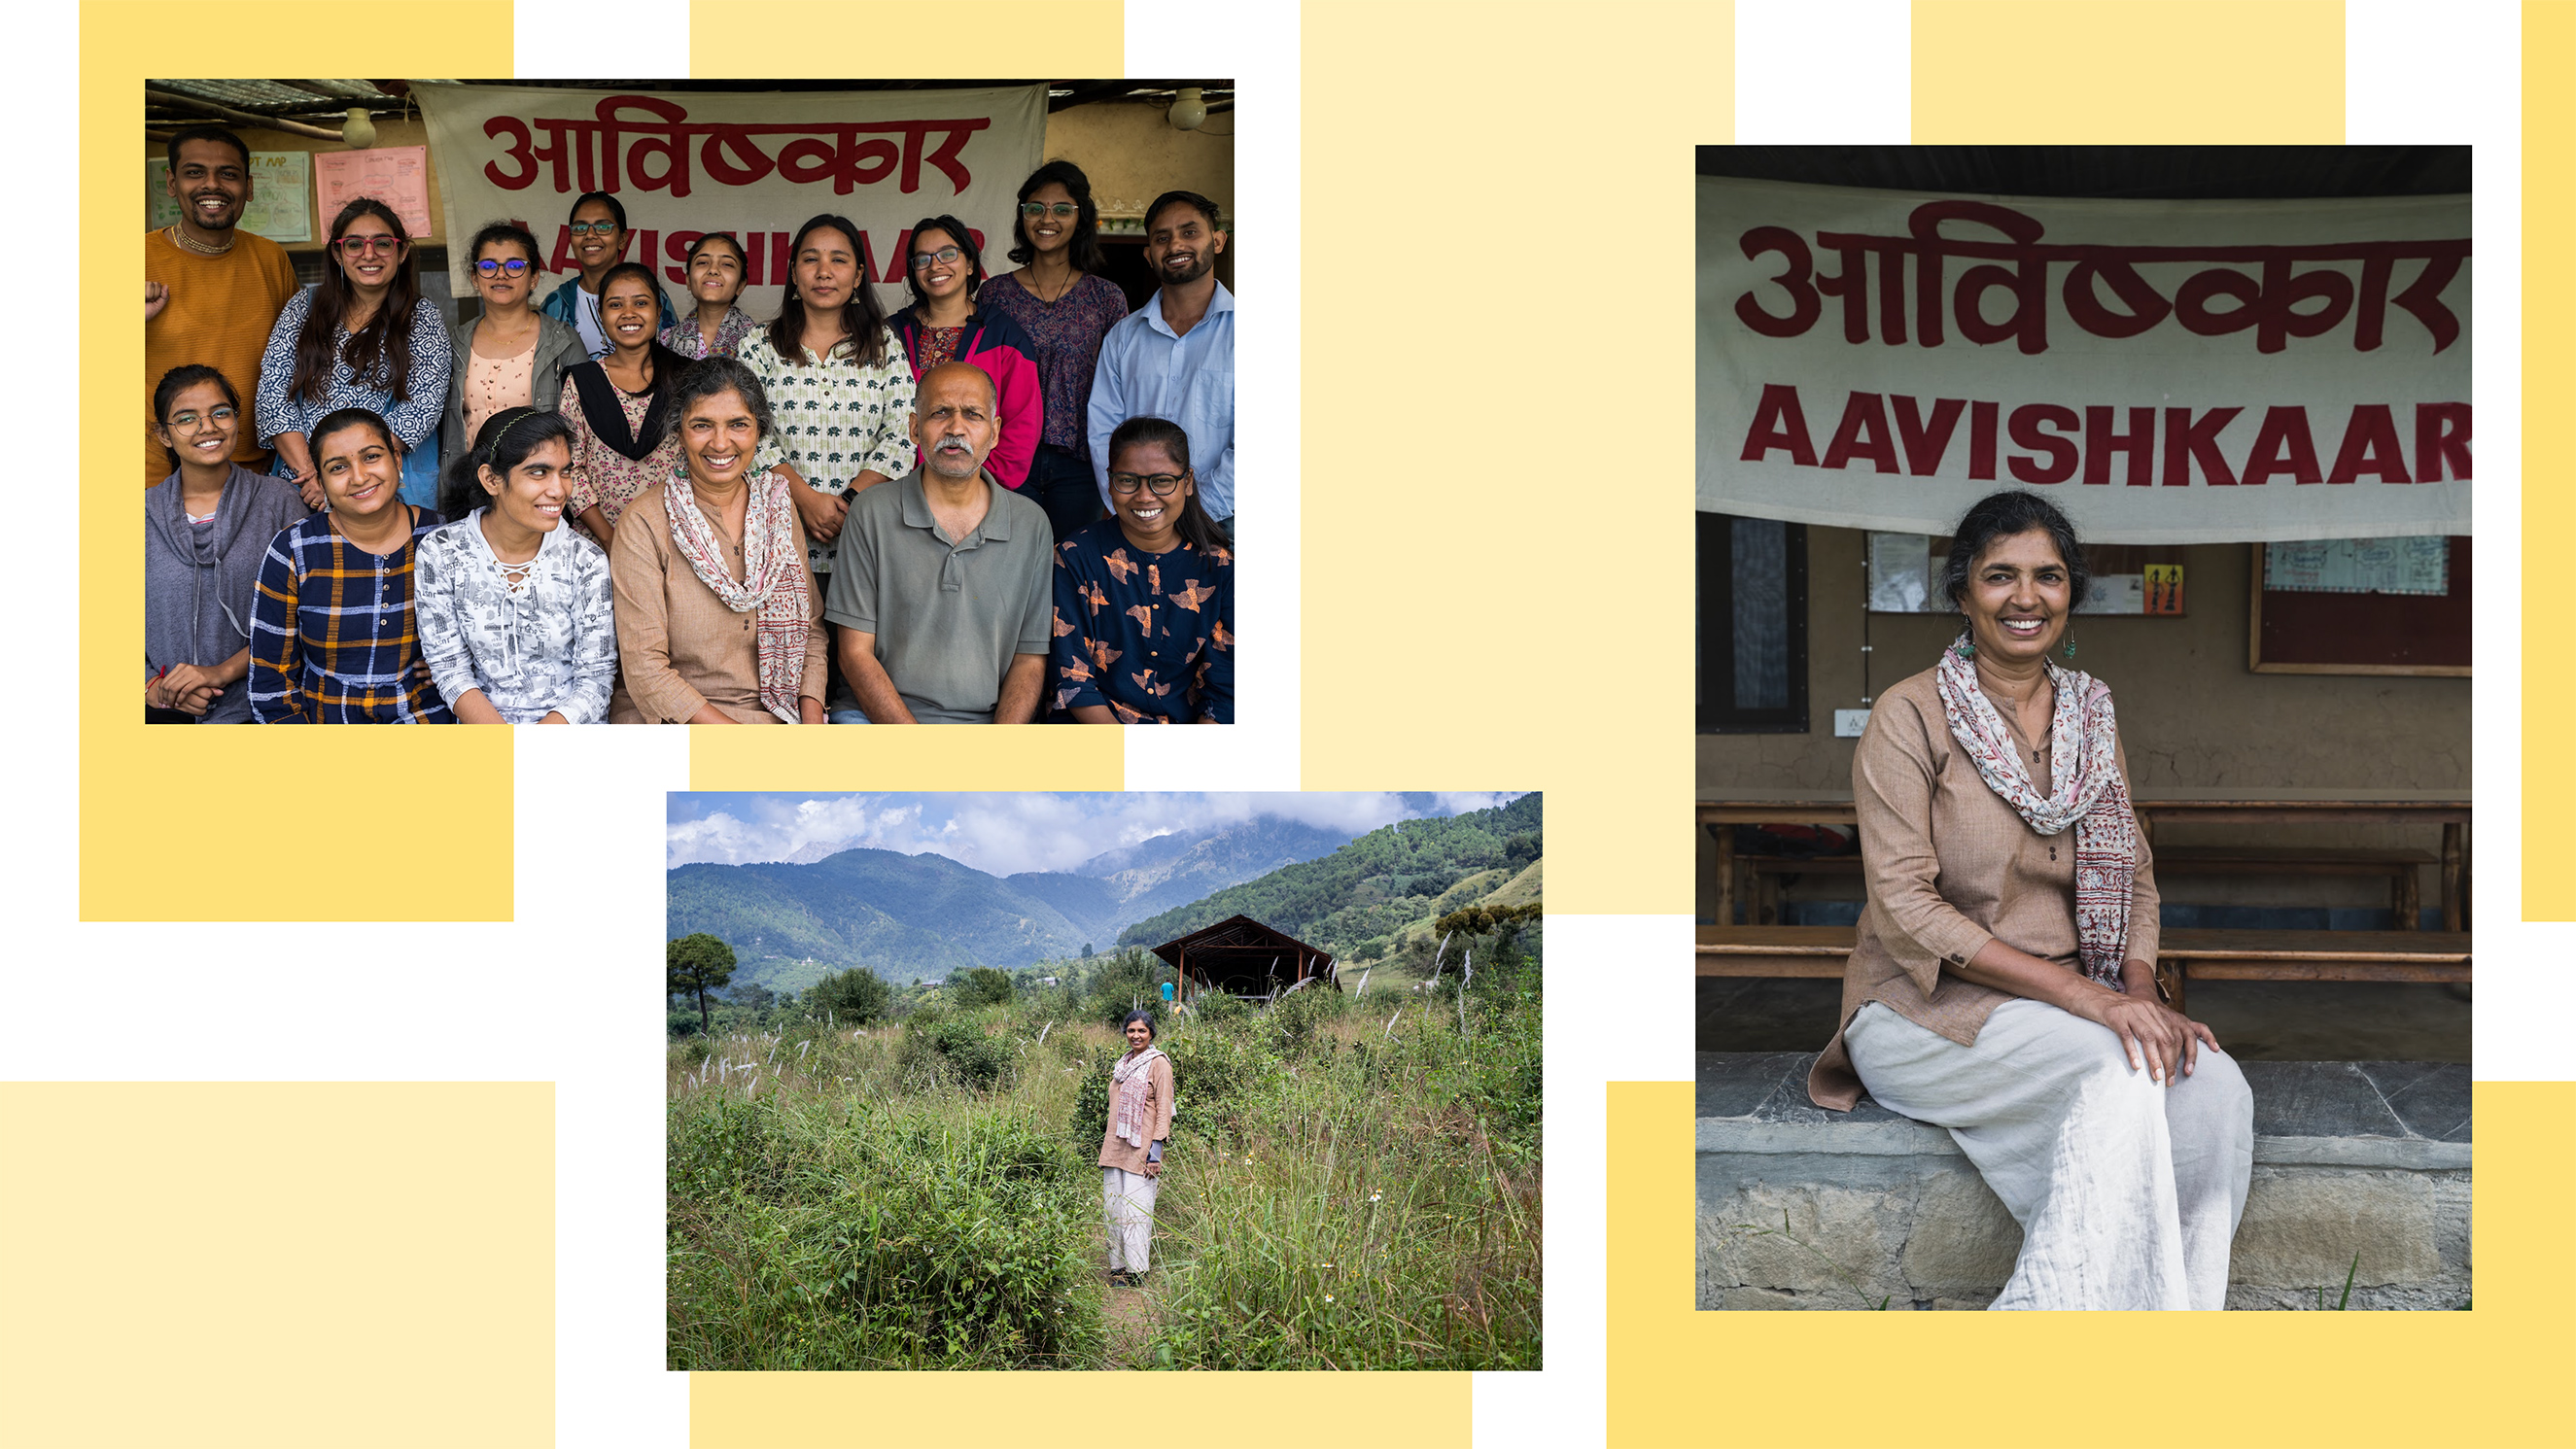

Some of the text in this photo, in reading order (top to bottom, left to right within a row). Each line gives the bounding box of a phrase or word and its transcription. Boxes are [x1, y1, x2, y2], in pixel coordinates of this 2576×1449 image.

[265, 156, 287, 167] MAP
[483, 95, 992, 197] आविष्कार
[1735, 201, 2472, 356] आविष्कार
[1740, 384, 2472, 486] AAVISHKAAR
